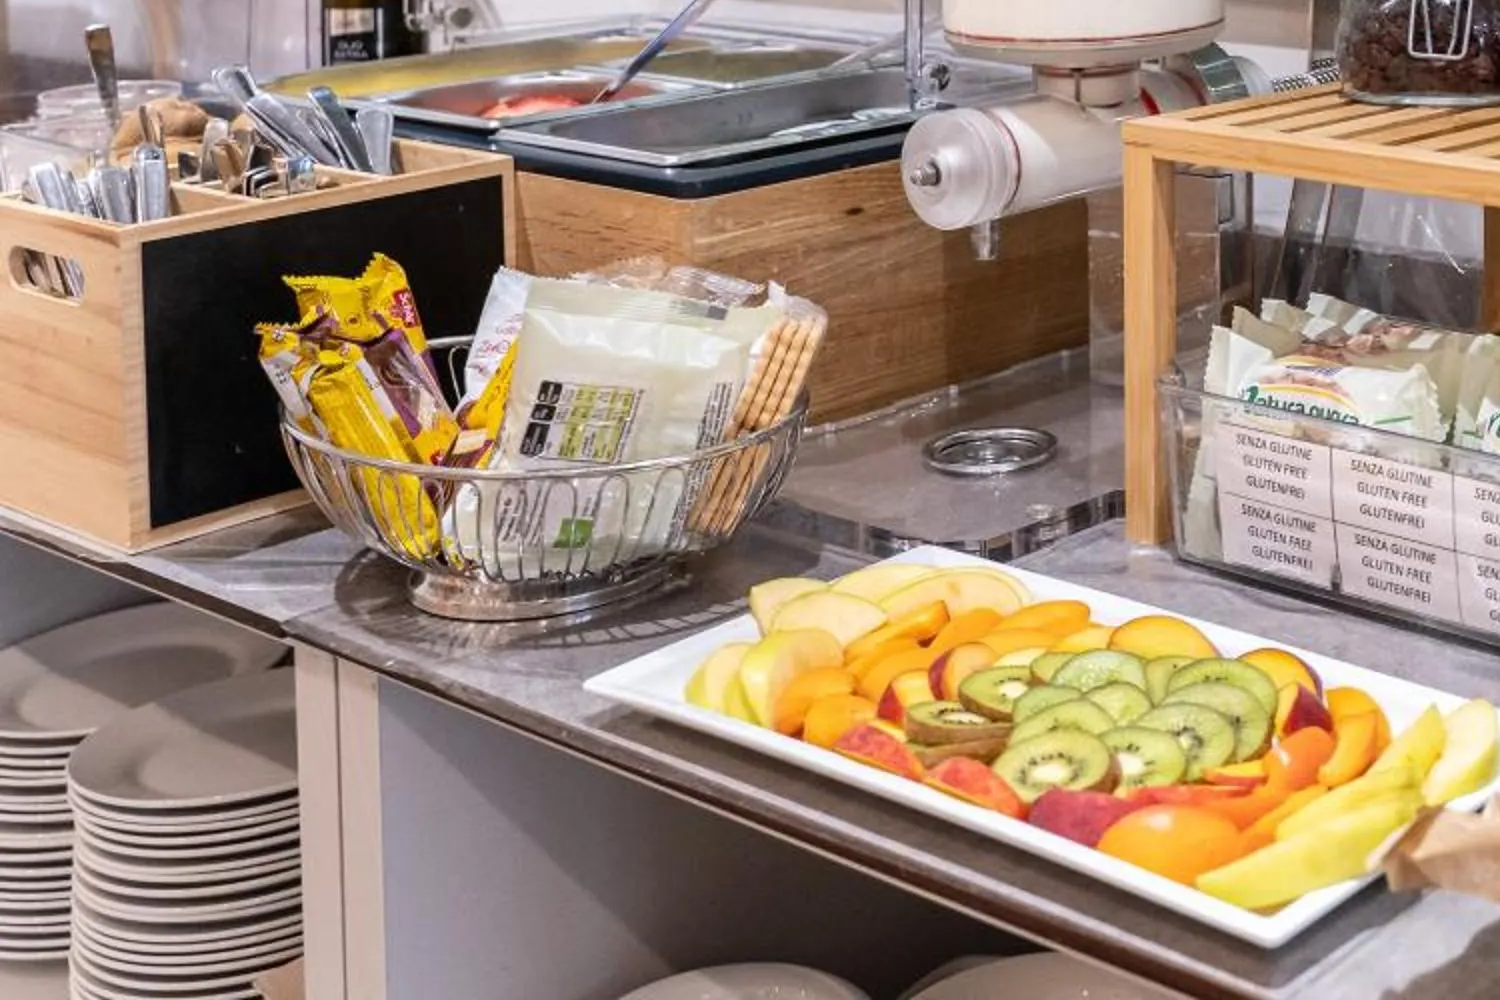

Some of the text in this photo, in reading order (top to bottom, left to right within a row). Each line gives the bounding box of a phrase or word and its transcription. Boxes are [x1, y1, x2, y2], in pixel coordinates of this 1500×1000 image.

[1236, 434, 1313, 461] SENZA GLUTINE
[1243, 455, 1309, 480] GLUTEN FREE
[1351, 459, 1434, 488] SENZA GLUTINE
[1245, 475, 1306, 500] GLUTENFREI
[1357, 481, 1429, 508] GLUTEN FREE
[1241, 503, 1317, 533] SENZA GLUTINE
[1359, 503, 1426, 529] GLUTENFREI
[1247, 525, 1314, 552] GLUTEN FREE
[1354, 533, 1437, 565] SENZA GLUTINE
[1251, 545, 1314, 570] GLUTENFREI
[1361, 555, 1433, 585] GLUTEN FREE
[1367, 576, 1432, 604] GLUTENFREI
